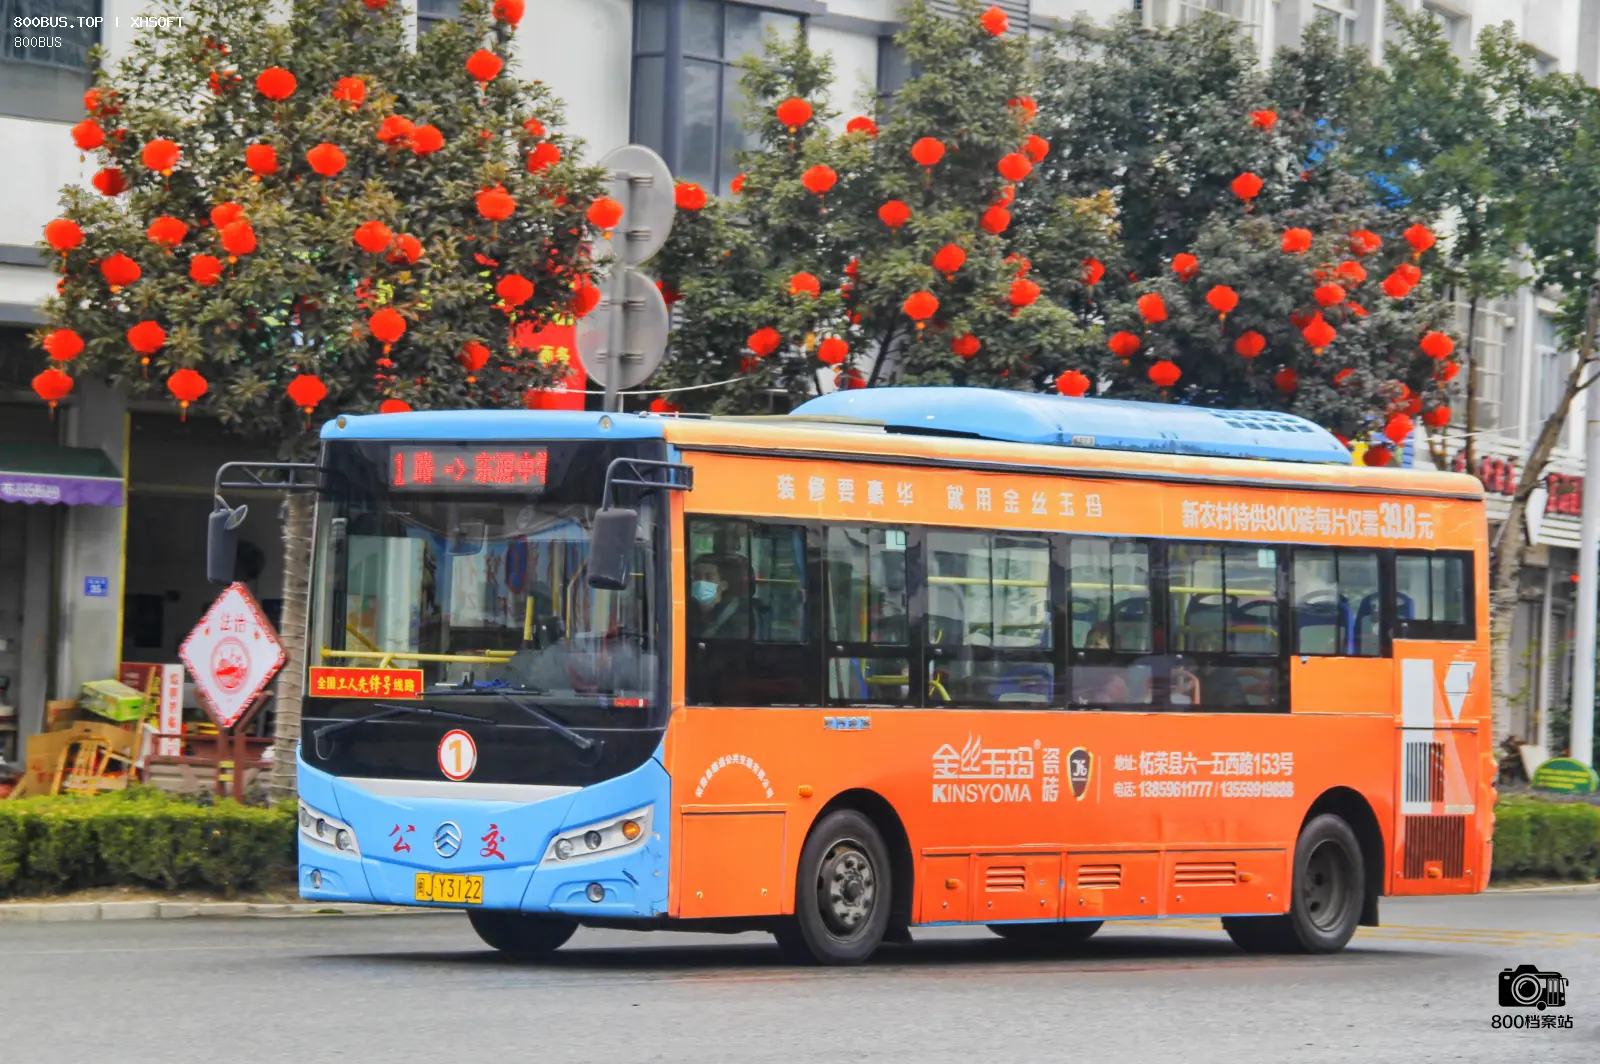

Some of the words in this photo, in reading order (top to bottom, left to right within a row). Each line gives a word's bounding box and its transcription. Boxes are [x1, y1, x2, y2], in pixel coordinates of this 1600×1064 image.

[777, 474, 914, 507] 装修要豪华
[946, 484, 1102, 517] 就用金丝玉玛
[317, 675, 415, 695] 全国工人先锋号线路
[449, 739, 462, 773] 1
[932, 730, 1034, 780] 金丝玉玛
[932, 783, 1032, 803] KINSYOMA
[1042, 747, 1061, 803] 瓷砖
